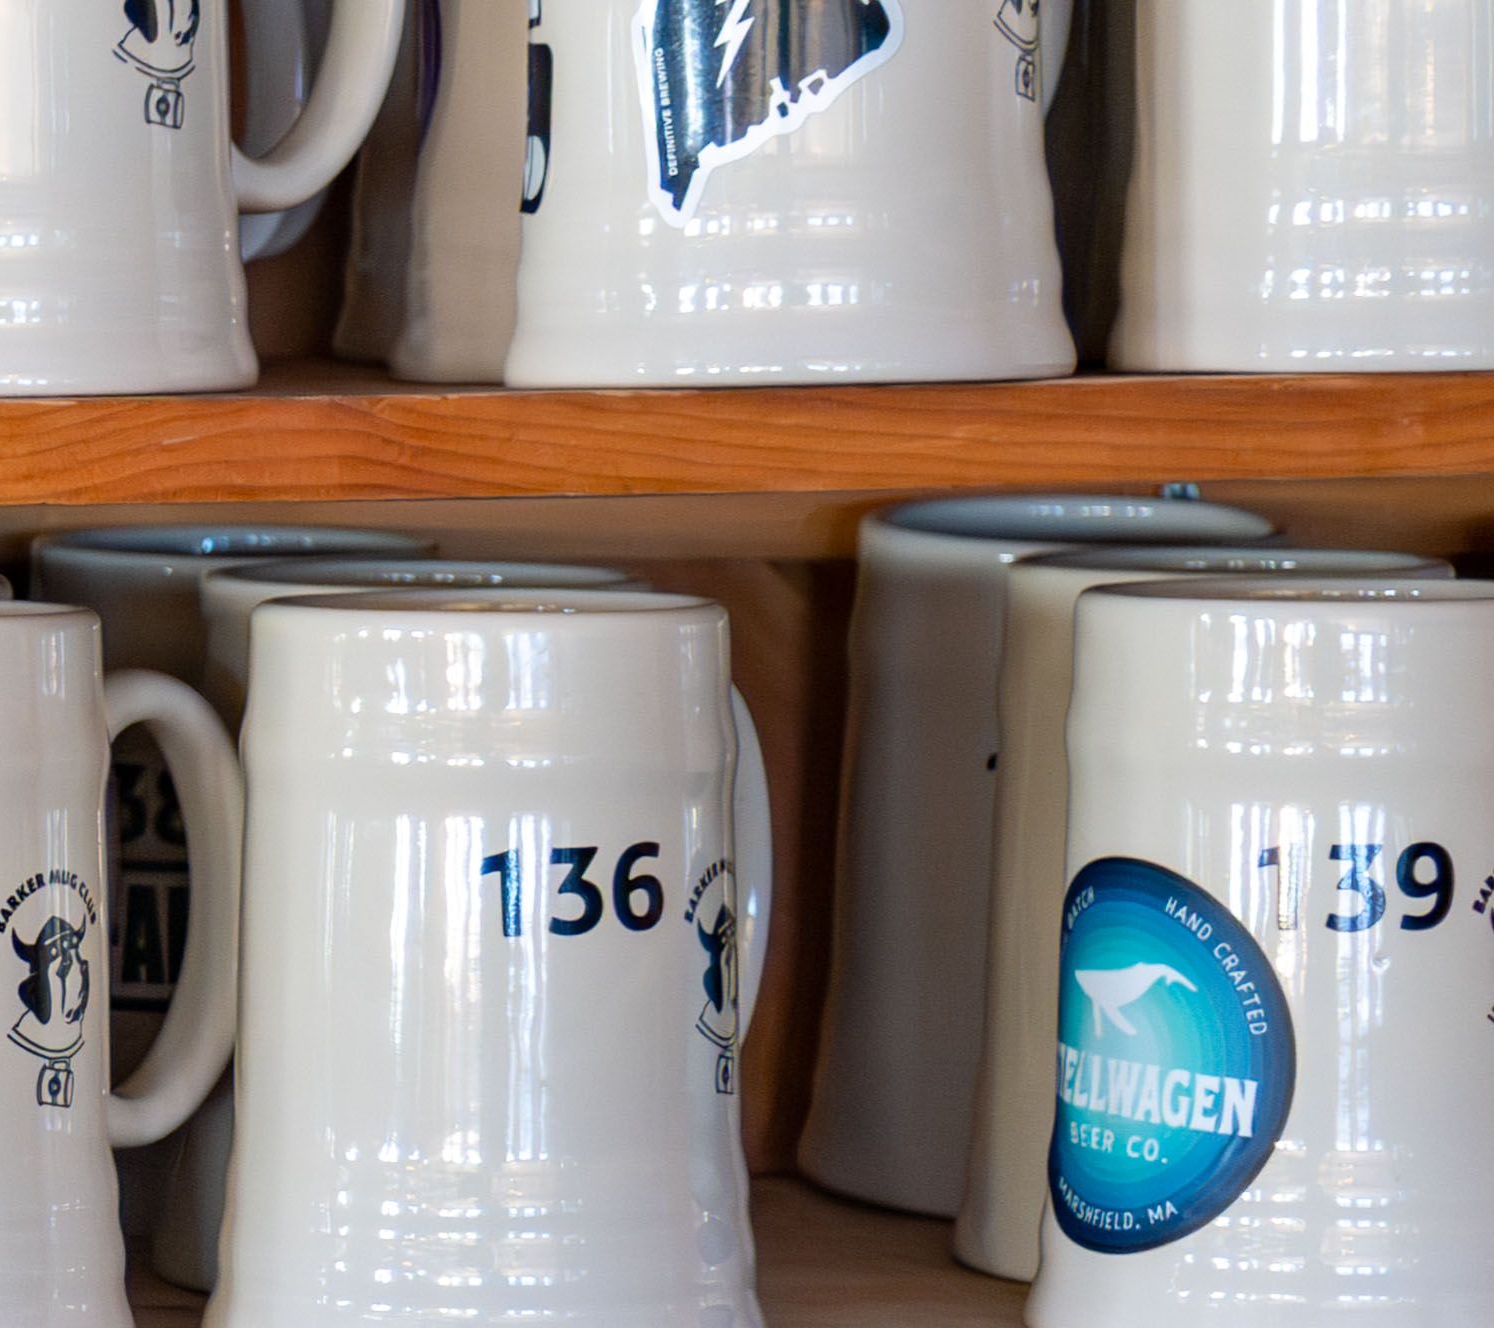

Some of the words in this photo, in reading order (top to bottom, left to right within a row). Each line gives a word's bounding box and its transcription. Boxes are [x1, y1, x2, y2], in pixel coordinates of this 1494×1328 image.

[656, 47, 671, 108] BREWING
[662, 111, 679, 176] DEFINITIVE
[48, 868, 78, 891] MUG
[77, 882, 99, 926] CLUB
[481, 840, 665, 937] 136
[1258, 841, 1455, 934] 139
[1165, 896, 1212, 943] HAND
[1212, 941, 1268, 1037] CRAFTED
[1071, 1121, 1114, 1154] BEER
[1125, 1135, 1169, 1165] CO.
[1148, 1200, 1179, 1227] MA
